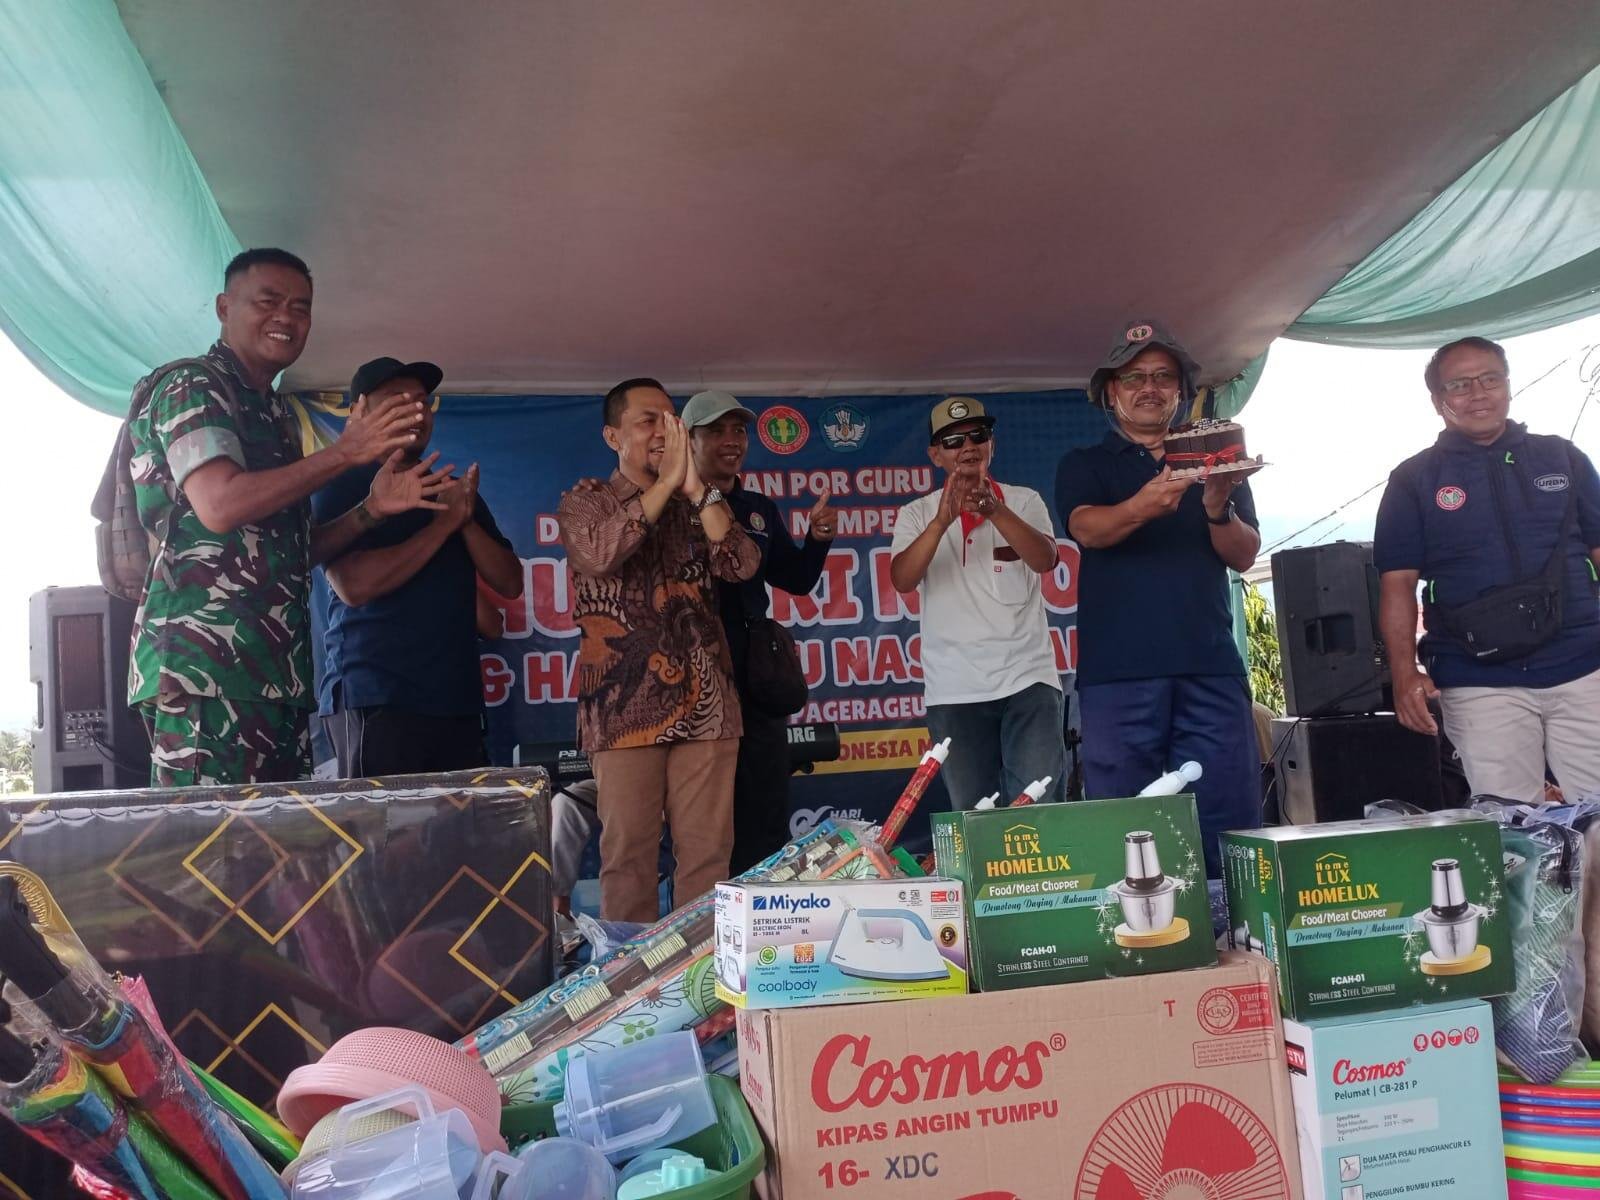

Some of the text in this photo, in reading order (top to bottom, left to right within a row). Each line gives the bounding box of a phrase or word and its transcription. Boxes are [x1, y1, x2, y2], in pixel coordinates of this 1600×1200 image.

[791, 471, 850, 496] POR
[856, 468, 931, 493] GURU
[1004, 832, 1039, 842] Home
[1006, 840, 1041, 855] LUX
[986, 854, 1071, 877] HOMELUX
[1315, 861, 1349, 871] Home
[1316, 869, 1351, 886] LUX
[989, 879, 1079, 897] Food/Meat Chopper
[1298, 883, 1380, 906] HOMELUX
[769, 893, 830, 913] Miyako
[1301, 908, 1387, 926] Food/Meat Chopper
[1021, 945, 1057, 956] FCAH-01
[758, 979, 817, 993] coolbody
[1331, 973, 1365, 985] FCAH-01
[1163, 1001, 1176, 1017] T
[1334, 1087, 1370, 1101] Pelumat
[1379, 1081, 1410, 1094] CB-281
[1412, 1080, 1418, 1089] P
[816, 1100, 1059, 1148] KIPAS ANGIN TUMPU
[1363, 1139, 1472, 1164] DUA MATA PISAU PENGHANCUR ES
[884, 1152, 939, 1181] XDC
[1365, 1177, 1456, 1199] PENGGILING BUMBU KERING
